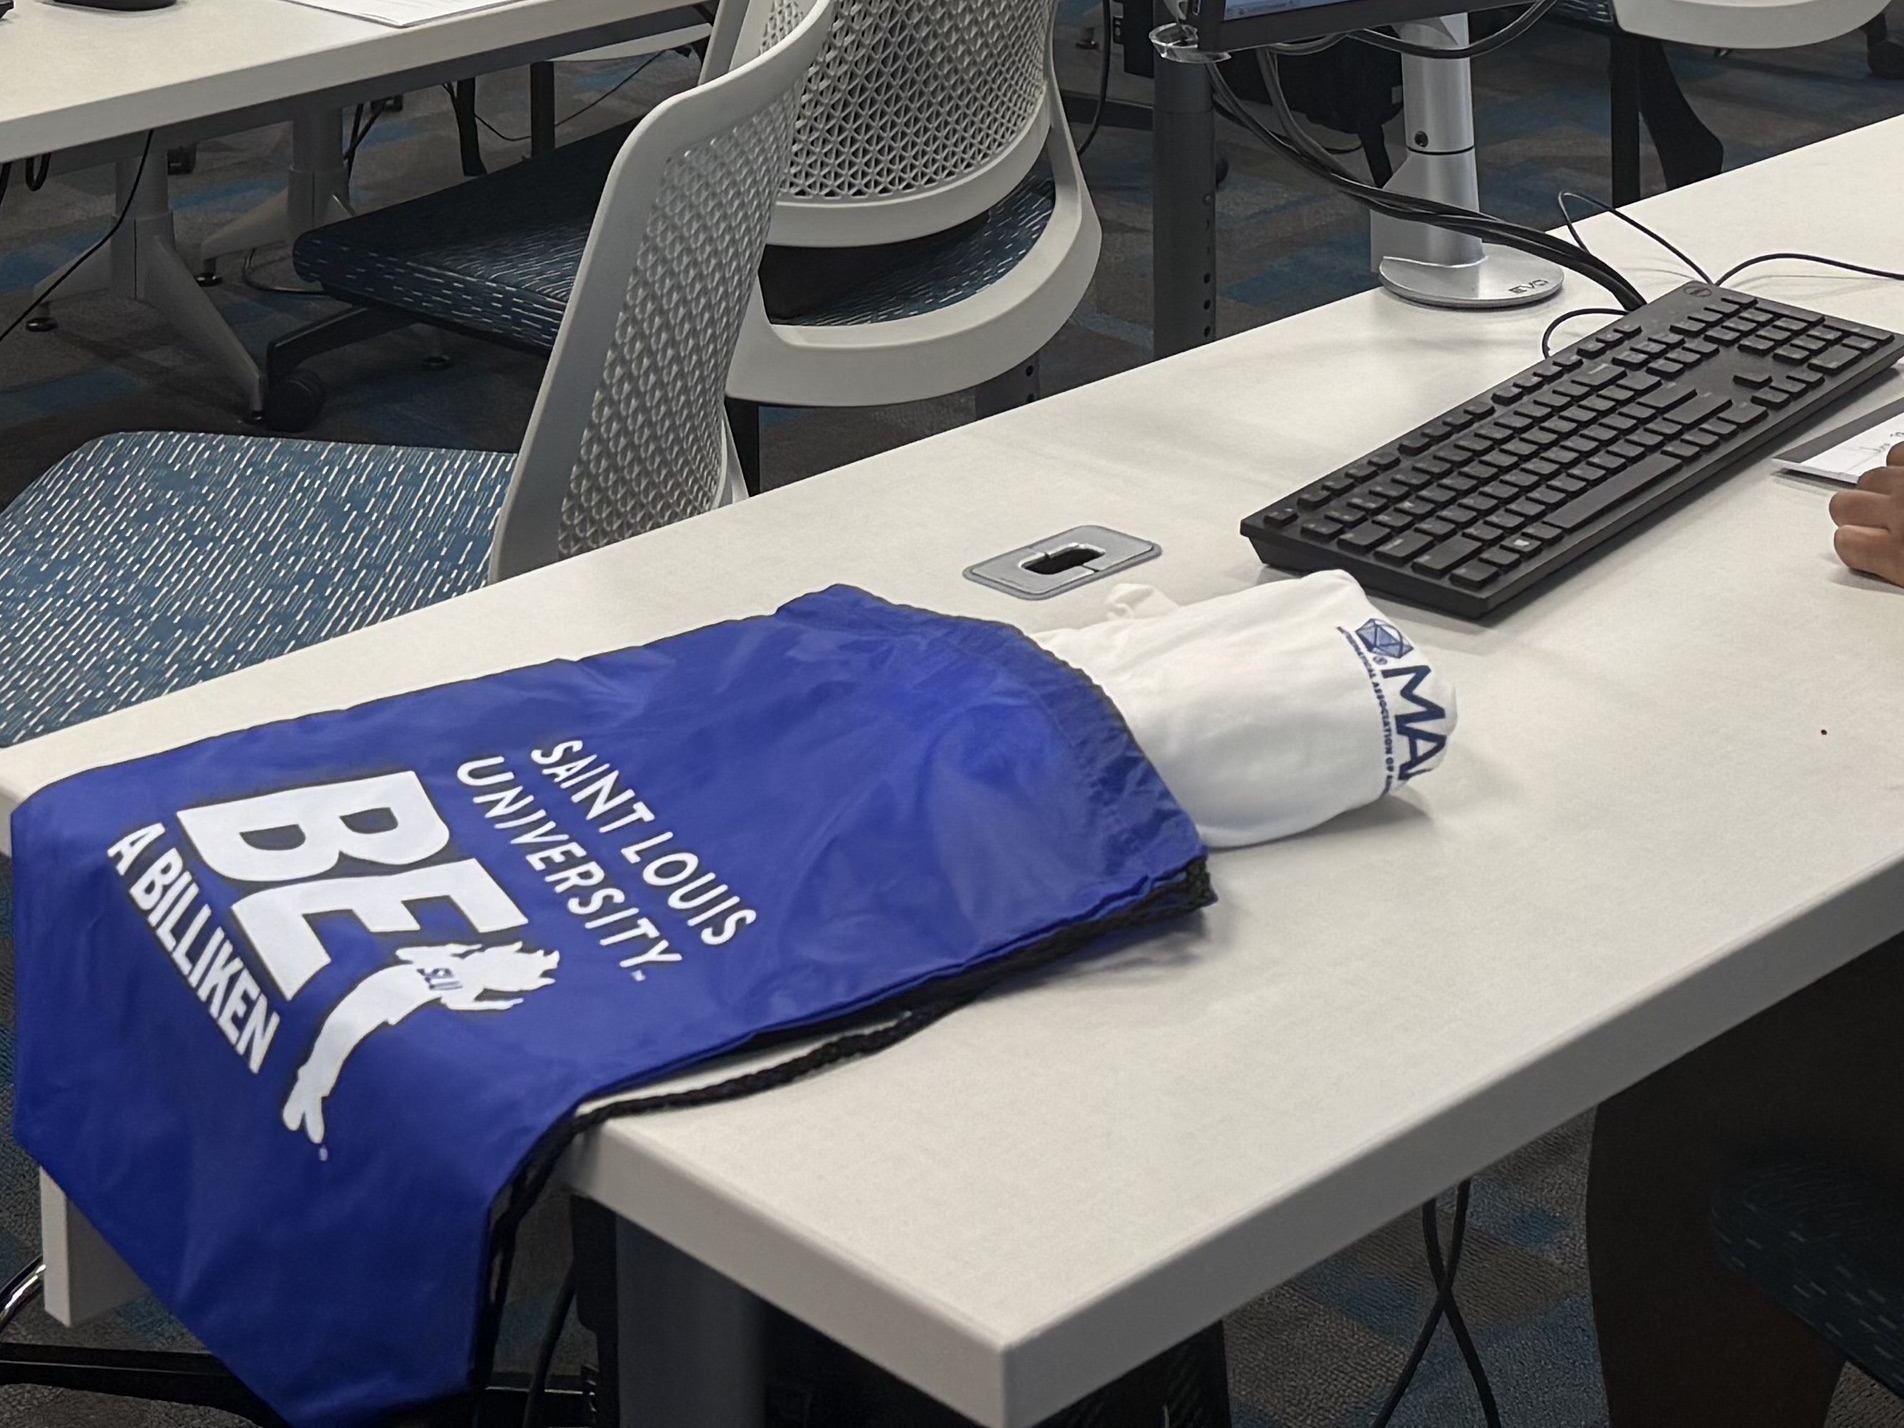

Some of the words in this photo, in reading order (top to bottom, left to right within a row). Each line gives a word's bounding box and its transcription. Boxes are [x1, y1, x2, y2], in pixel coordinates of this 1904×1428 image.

[1508, 279, 1549, 295] EVO
[1372, 681, 1394, 756] ASSOCIATION
[1381, 664, 1448, 781] MA
[106, 822, 167, 876] A
[176, 770, 529, 1001] BE
[530, 739, 656, 834] SAINT
[620, 831, 757, 946] LOUIS
[129, 847, 281, 1074] BILLIKEN
